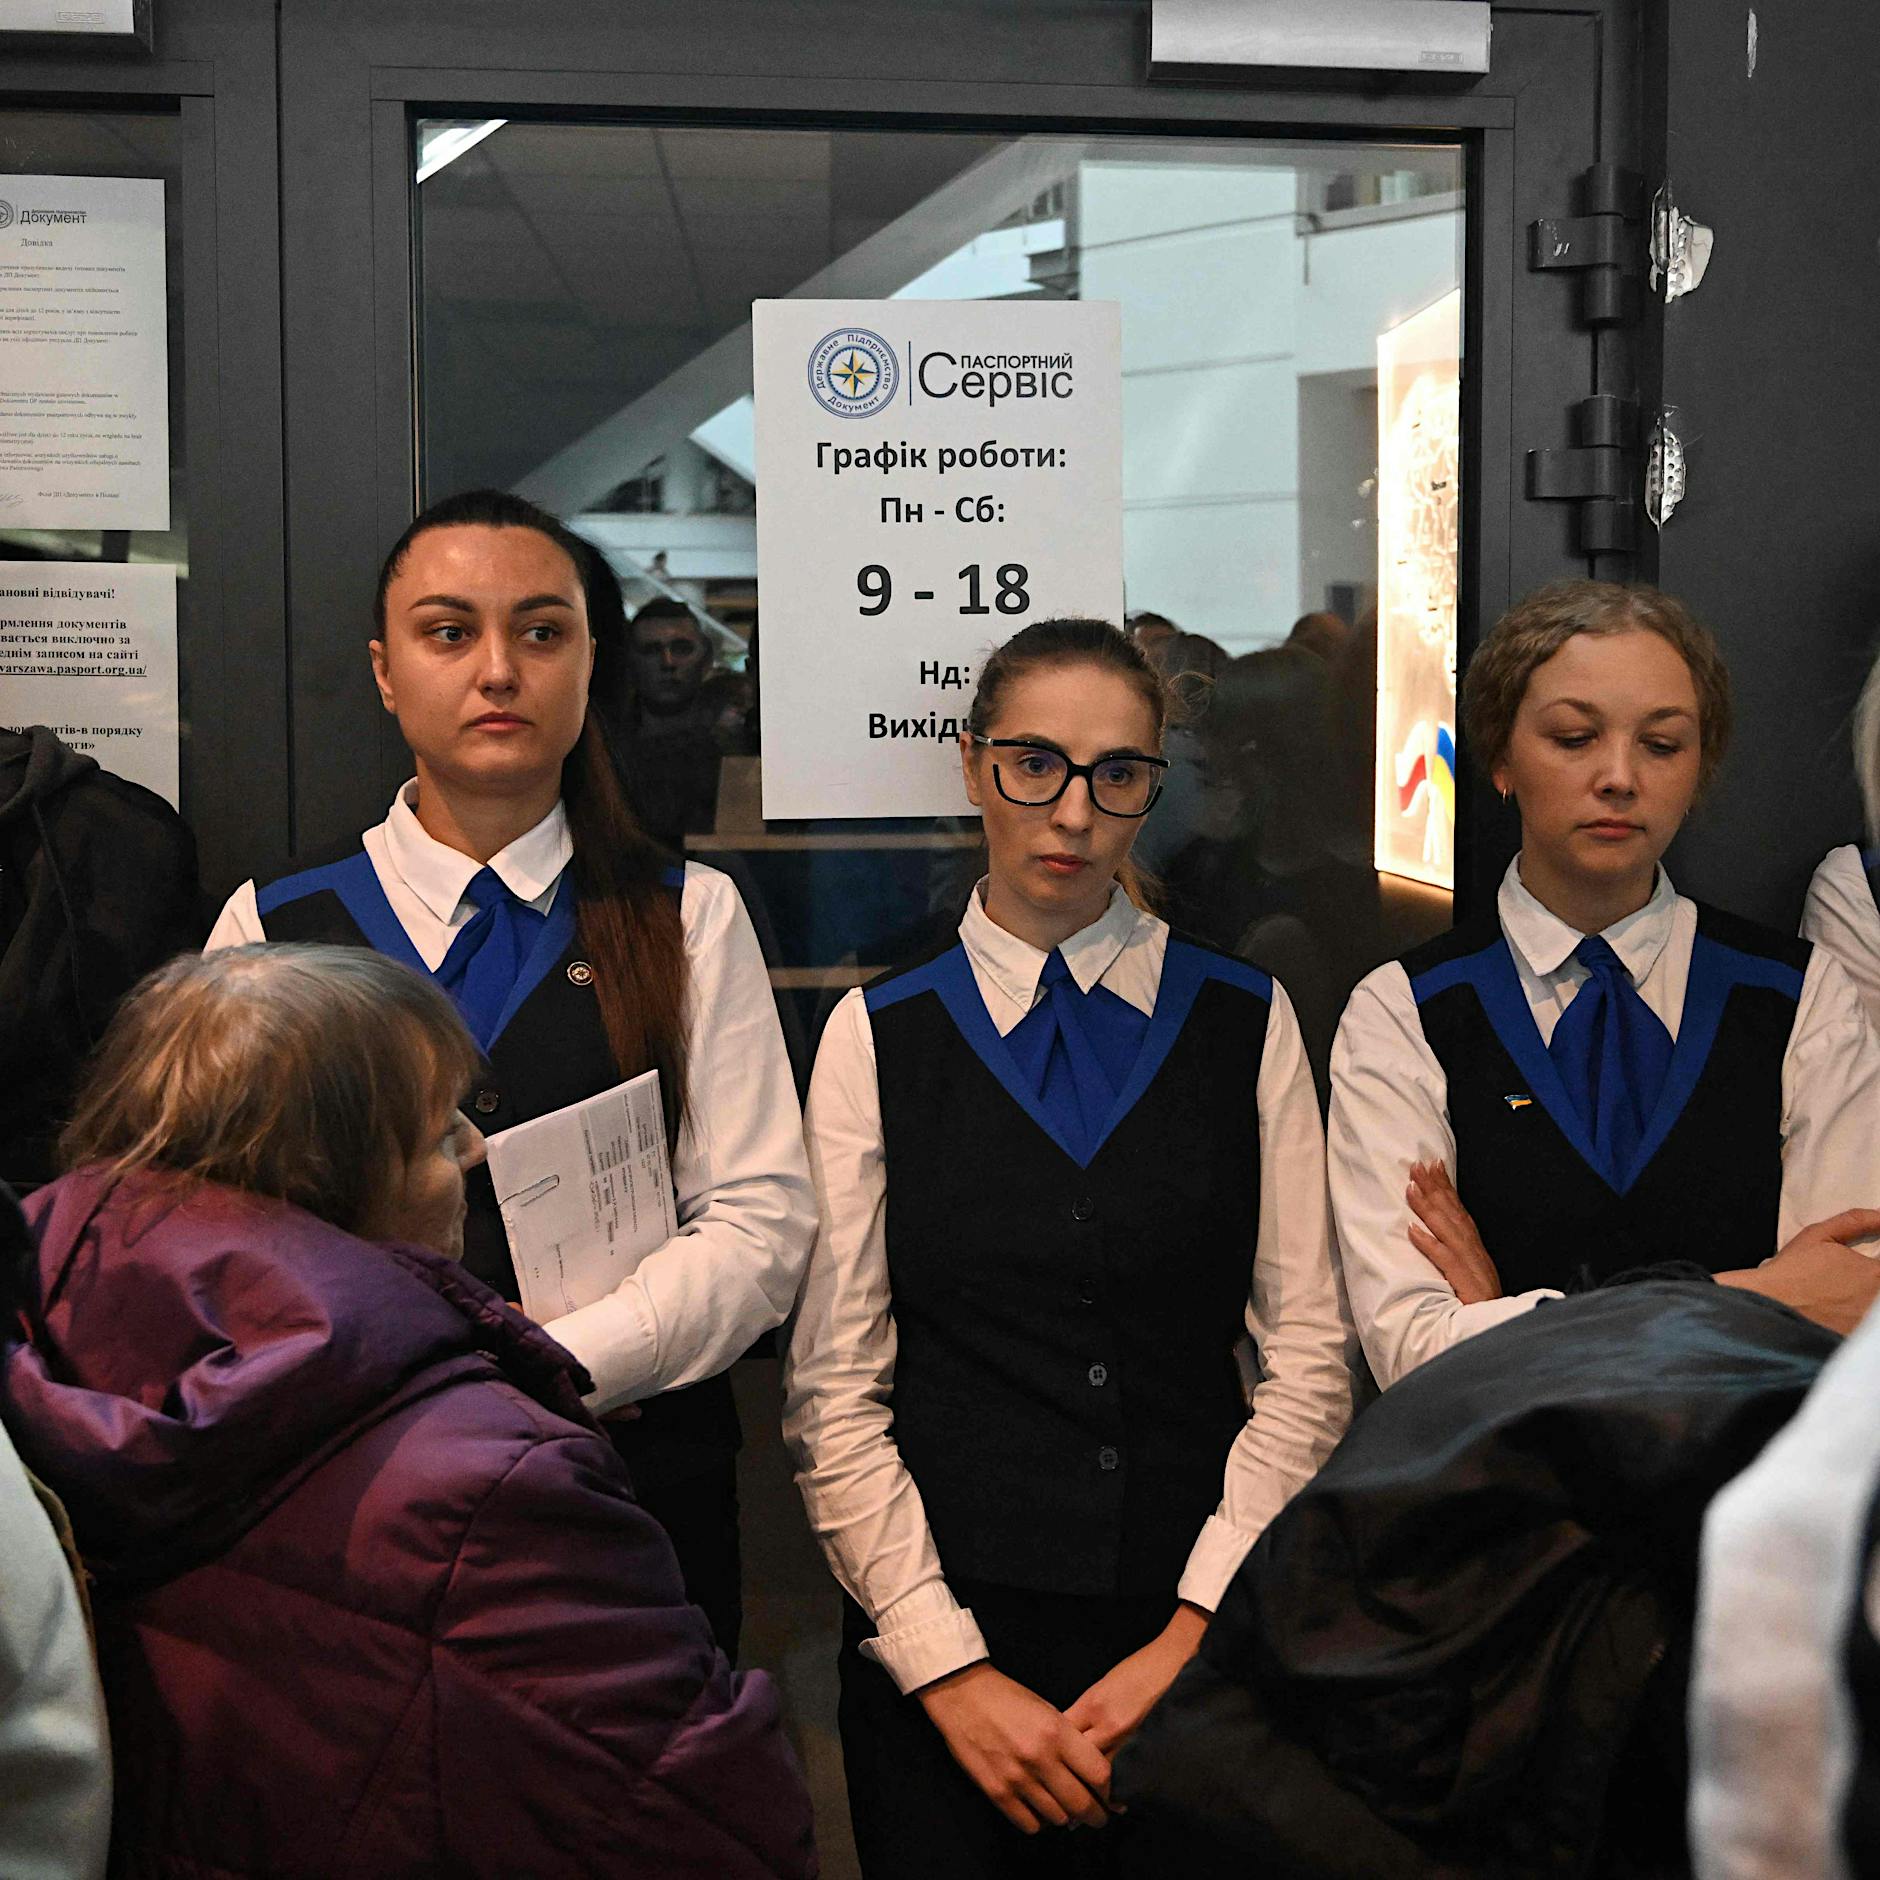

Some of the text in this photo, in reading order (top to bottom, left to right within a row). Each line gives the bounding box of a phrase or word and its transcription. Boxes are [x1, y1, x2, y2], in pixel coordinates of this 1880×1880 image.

[20, 210, 87, 226] Документ
[961, 352, 1073, 369] ПАСПОРТНИЙ
[827, 395, 880, 413] Документ
[816, 440, 1066, 475] Графік роботи:
[880, 497, 925, 523] Пн
[955, 494, 1005, 524] Сб:
[42, 587, 116, 601] відвідувачі!
[856, 563, 1031, 617] 9 - 18
[56, 618, 128, 632] документів
[52, 635, 115, 645] виключно
[118, 636, 131, 645] за
[35, 650, 85, 660] записом
[89, 651, 103, 660] на
[106, 649, 139, 661] сайті
[919, 661, 971, 688] Нд:
[92, 725, 144, 739] порядку
